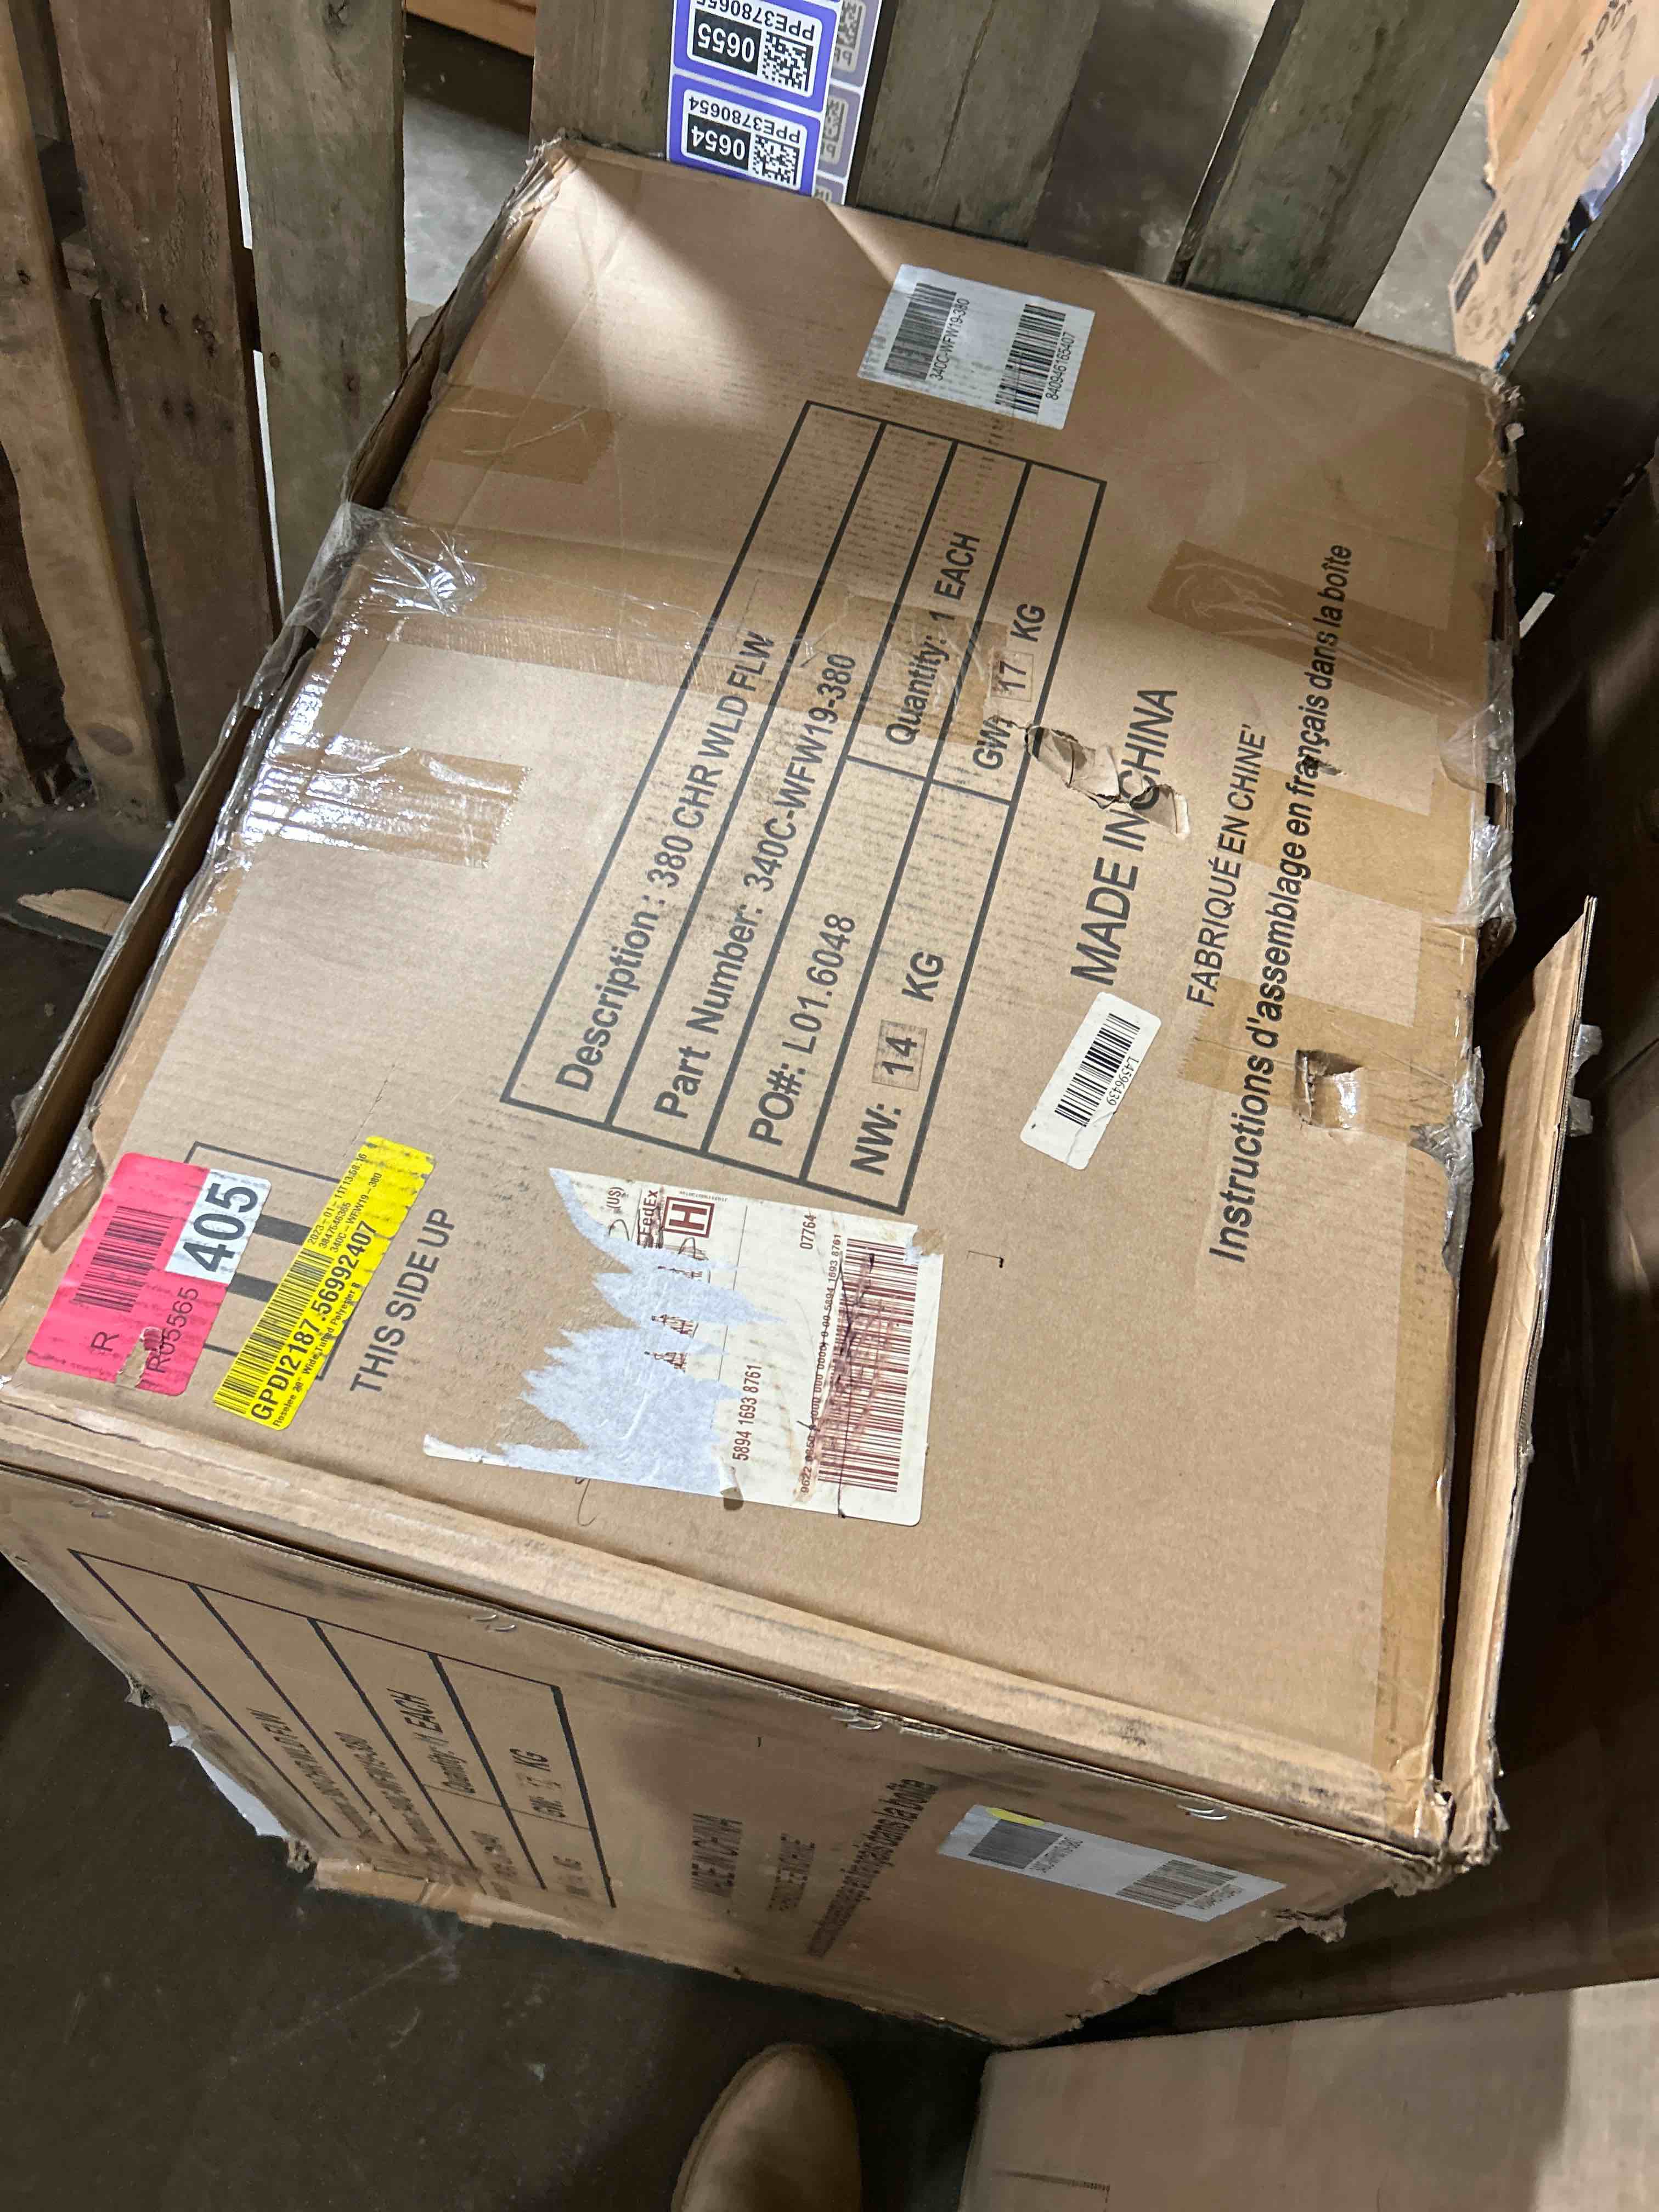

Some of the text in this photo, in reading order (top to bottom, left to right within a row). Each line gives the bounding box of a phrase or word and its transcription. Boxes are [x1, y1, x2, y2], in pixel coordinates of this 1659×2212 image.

[696, 0, 815, 41] PPE37806
[697, 22, 755, 63] 0655
[688, 96, 801, 143] PPE3780654
[691, 125, 746, 161] 0654
[884, 531, 981, 746] Quantity: 1 EACH
[1009, 603, 1046, 642] KG
[726, 630, 775, 692] FLW
[997, 660, 1026, 690] 17
[697, 695, 749, 759] WLD
[672, 764, 723, 829] CHR
[646, 834, 693, 888] 380
[1070, 689, 1178, 986] MADE IN CHINA
[653, 1045, 712, 1120] Part
[685, 904, 763, 1035] Number:
[743, 653, 856, 893] 340C-WFW19-380
[1186, 855, 1242, 1007] FABRIQUÉ
[1217, 814, 1250, 855] EN
[1209, 544, 1352, 1263] Instructions d'assemblage en français dans la boîte
[747, 913, 856, 1147] PO#: L01.6048
[849, 951, 944, 1176] NW: 14 KG
[606, 1186, 624, 1209] (US)
[640, 1189, 659, 1236] FedEx
[182, 1182, 258, 1272] 405
[799, 1214, 817, 1250] 07764
[831, 1233, 842, 1256] 8761
[349, 1209, 455, 1392] THIS SIDE UP
[828, 1260, 838, 1283] 1693
[90, 1331, 120, 1352] R
[145, 1286, 199, 1373] R05565
[272, 1394, 297, 1427] Roselee
[302, 1352, 320, 1374] Wide
[732, 1364, 762, 1462] 5894 1693 8761
[386, 1688, 443, 1734] EACH
[509, 1748, 551, 1772] KG
